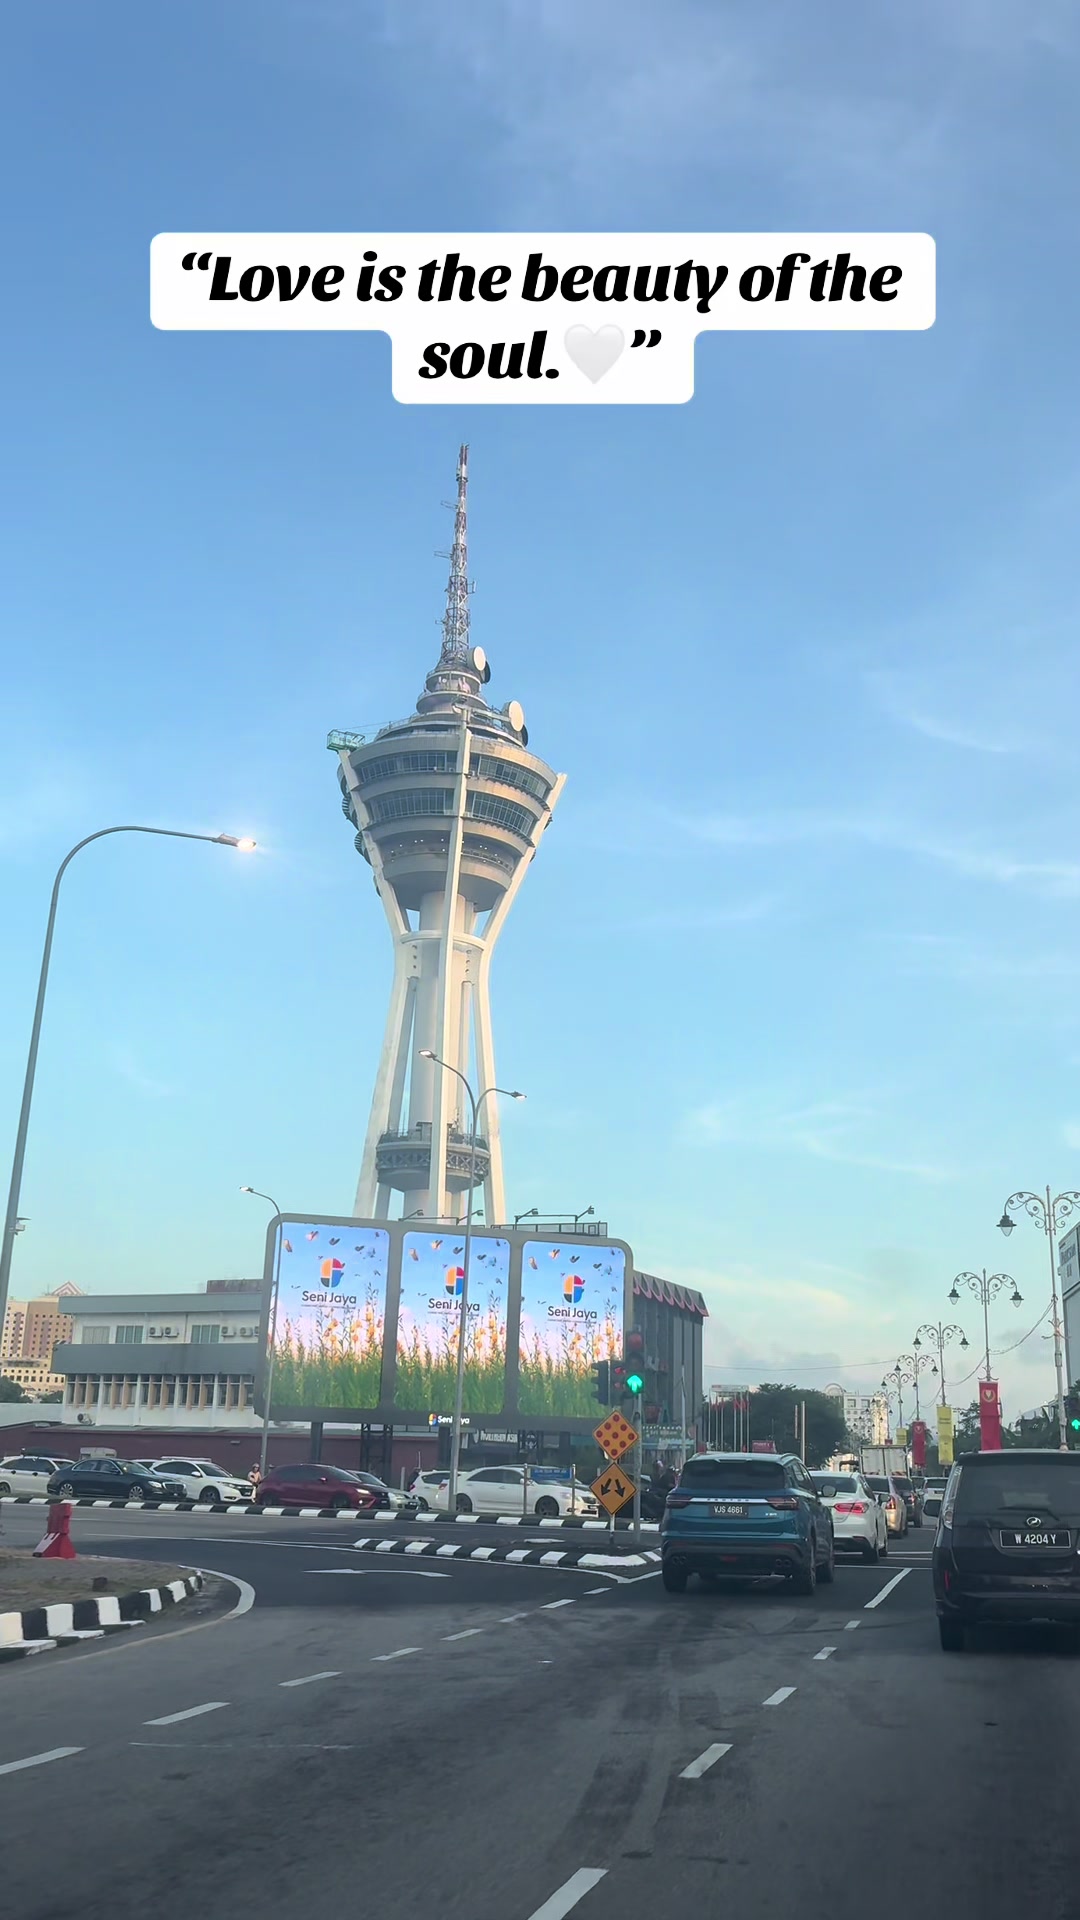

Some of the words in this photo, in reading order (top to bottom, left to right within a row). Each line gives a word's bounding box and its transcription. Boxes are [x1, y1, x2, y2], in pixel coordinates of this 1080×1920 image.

[301, 1290, 328, 1303] Seni
[329, 1292, 357, 1306] Jaya
[428, 1297, 453, 1310] Seni
[547, 1305, 571, 1318] Seni
[572, 1307, 598, 1321] Jaya
[727, 1505, 744, 1515] 4661
[1014, 1533, 1022, 1544] W
[1024, 1533, 1049, 1544] 4204
[1050, 1533, 1057, 1544] Y
